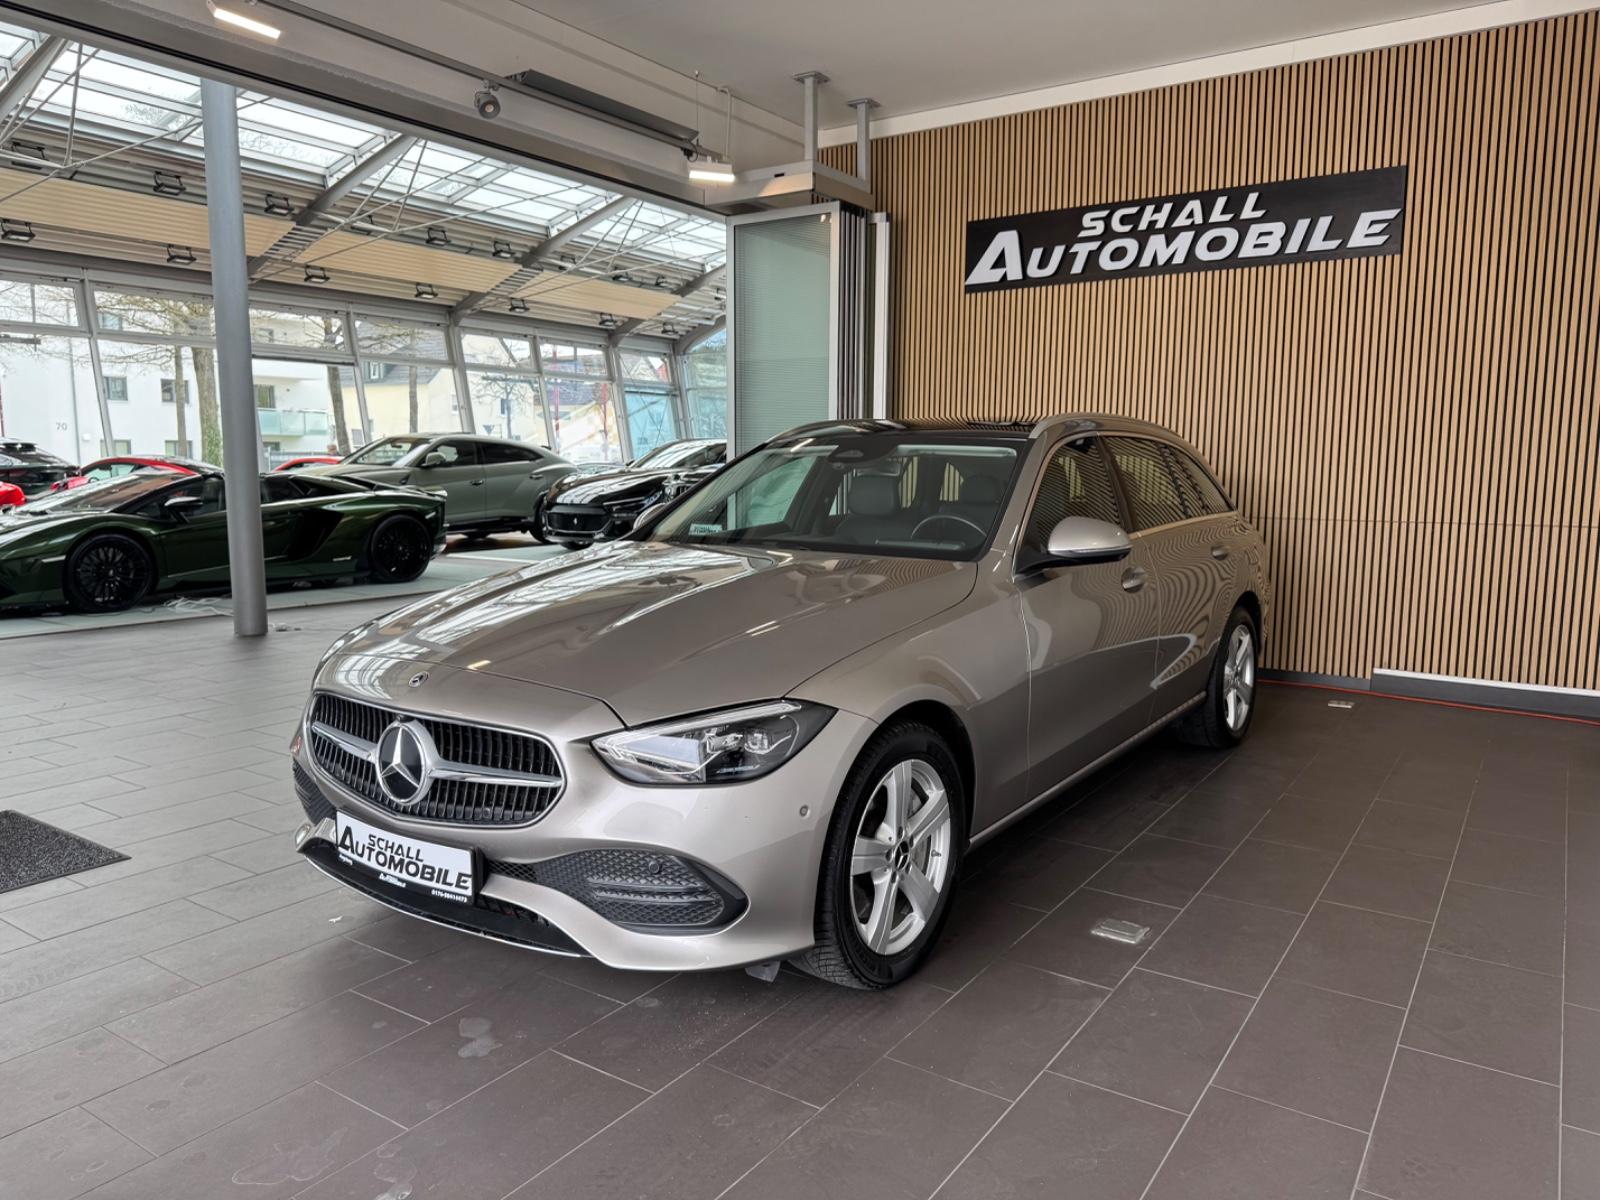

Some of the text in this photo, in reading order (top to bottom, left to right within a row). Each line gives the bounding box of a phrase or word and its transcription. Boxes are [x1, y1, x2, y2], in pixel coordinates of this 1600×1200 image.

[1079, 192, 1266, 238] SCHALL
[965, 208, 1402, 286] AUTOMOBILE
[55, 421, 68, 431] 70
[339, 825, 472, 890] AUTOMOBILE
[368, 834, 424, 862] SCHALL
